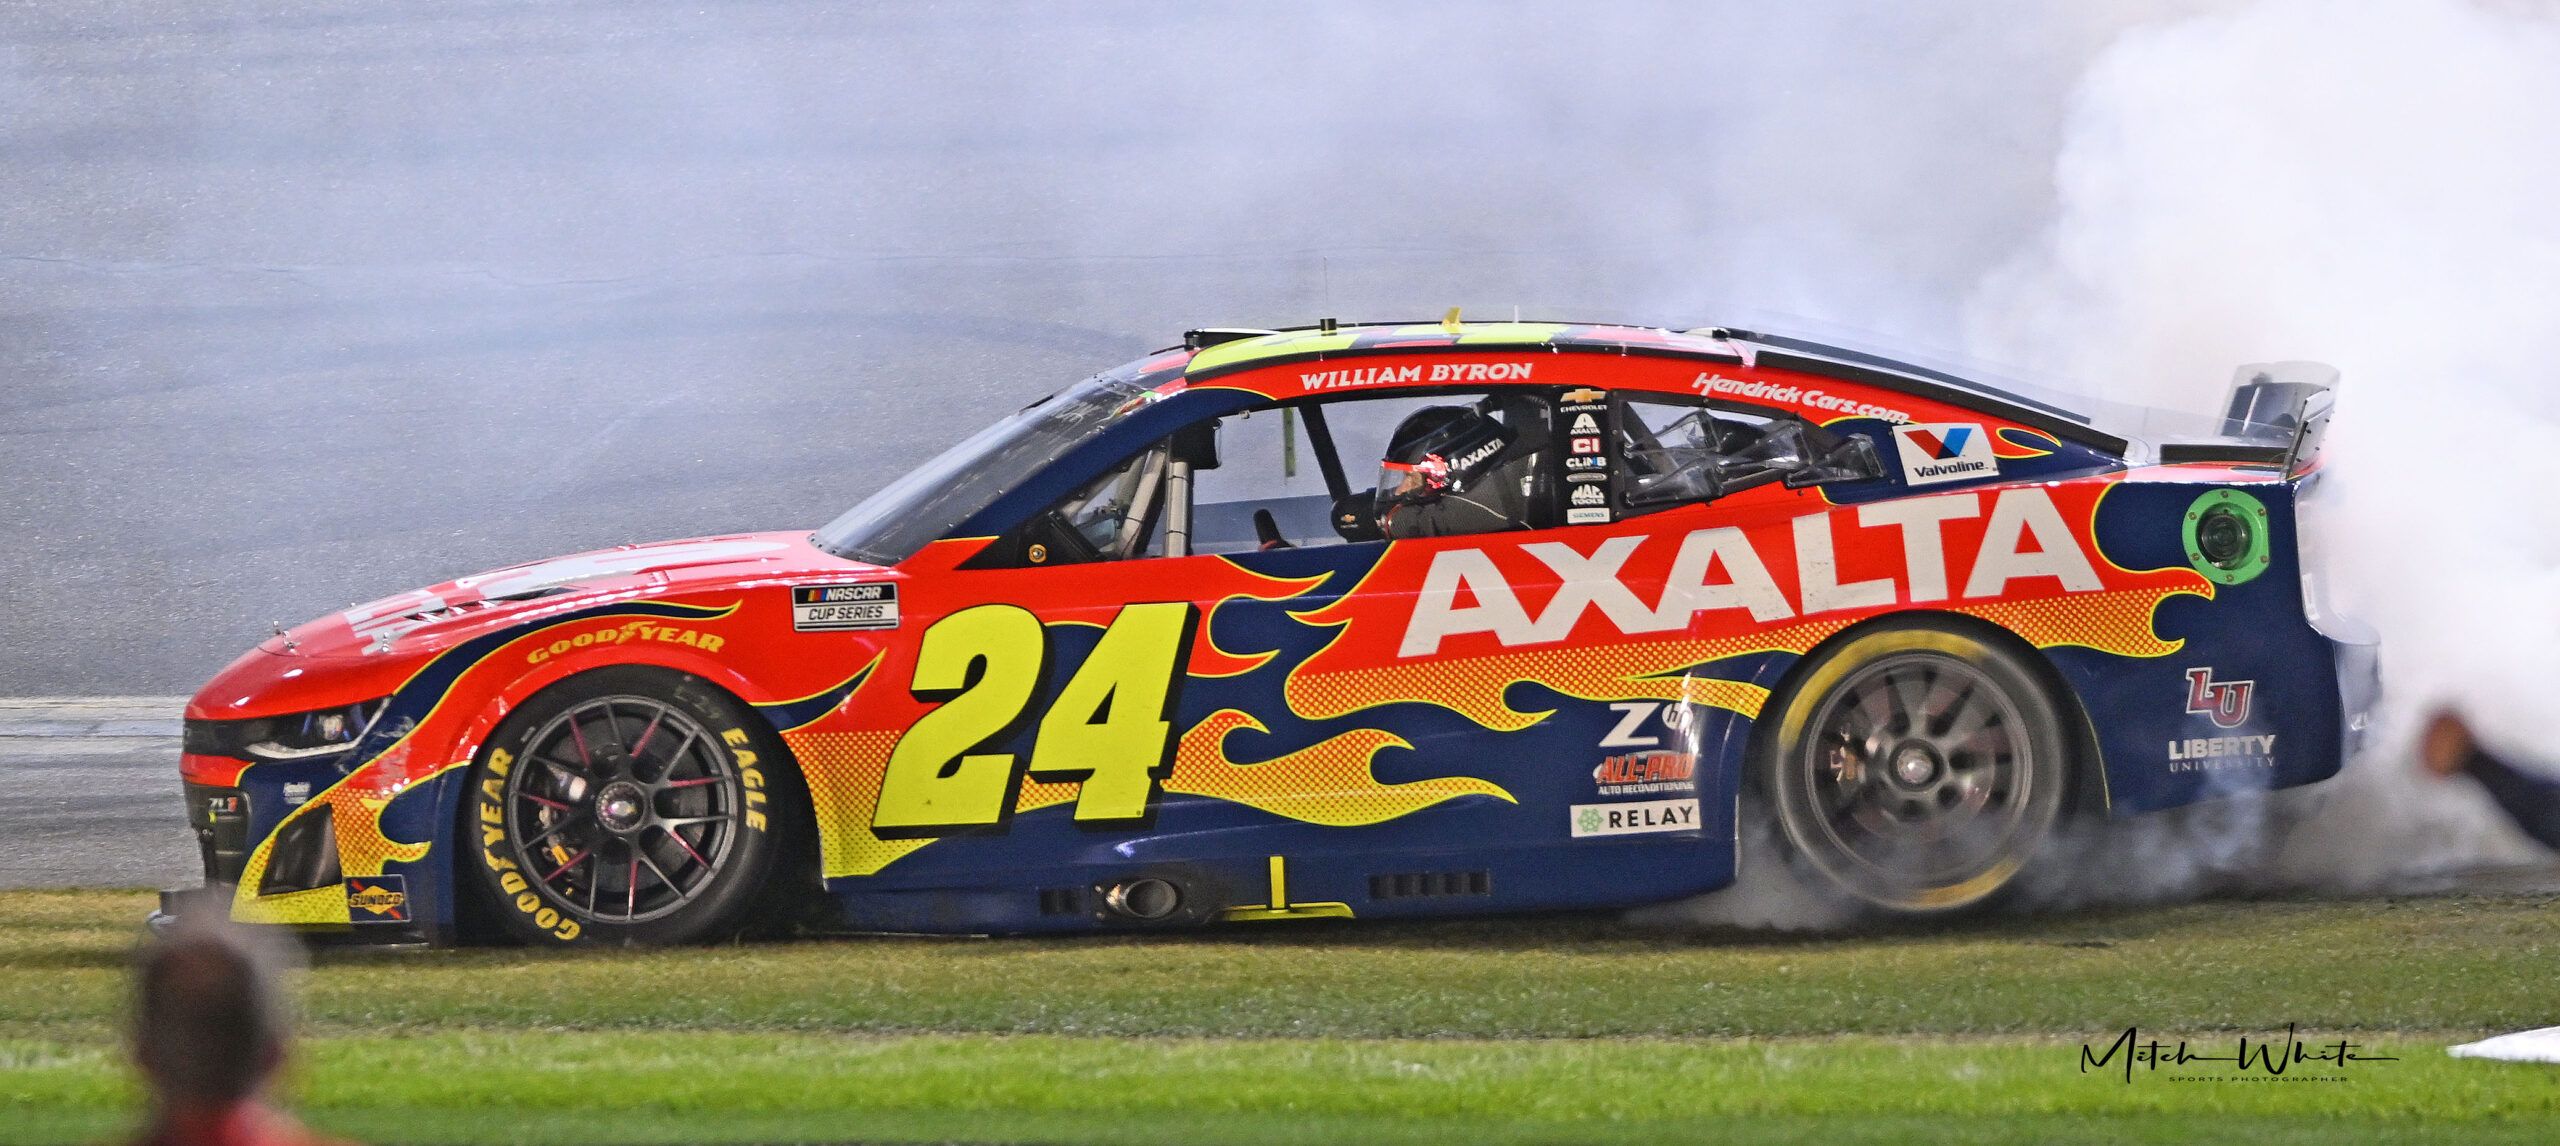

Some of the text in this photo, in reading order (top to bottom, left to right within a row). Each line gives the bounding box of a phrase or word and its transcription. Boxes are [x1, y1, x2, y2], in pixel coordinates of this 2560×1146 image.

[1300, 362, 1534, 391] WILLIAM BYRON
[1560, 404, 1608, 413] CHEVROLET
[1570, 427, 1601, 435] AXALTA
[1450, 438, 1505, 471] AXALTA
[1914, 461, 1985, 478] Valvoline
[1571, 484, 1604, 499] MAC
[1571, 498, 1605, 506] TOOLS
[1573, 511, 1605, 519] SIEMENS
[1397, 487, 2106, 659] AXALTA
[826, 587, 882, 601] NASCAR
[808, 606, 883, 621] CUP SERIES
[526, 620, 726, 665] GOODYEAR
[870, 602, 1202, 841] 24
[2168, 734, 2276, 760] LIBERTY
[1596, 752, 1697, 784] ALL-PRO
[2169, 757, 2275, 773] UNIVERSITY
[721, 727, 768, 833] EAGLE
[1598, 784, 1620, 795] AUTO
[1608, 806, 1693, 829] RELAY
[481, 746, 581, 941] GOODYEAR
